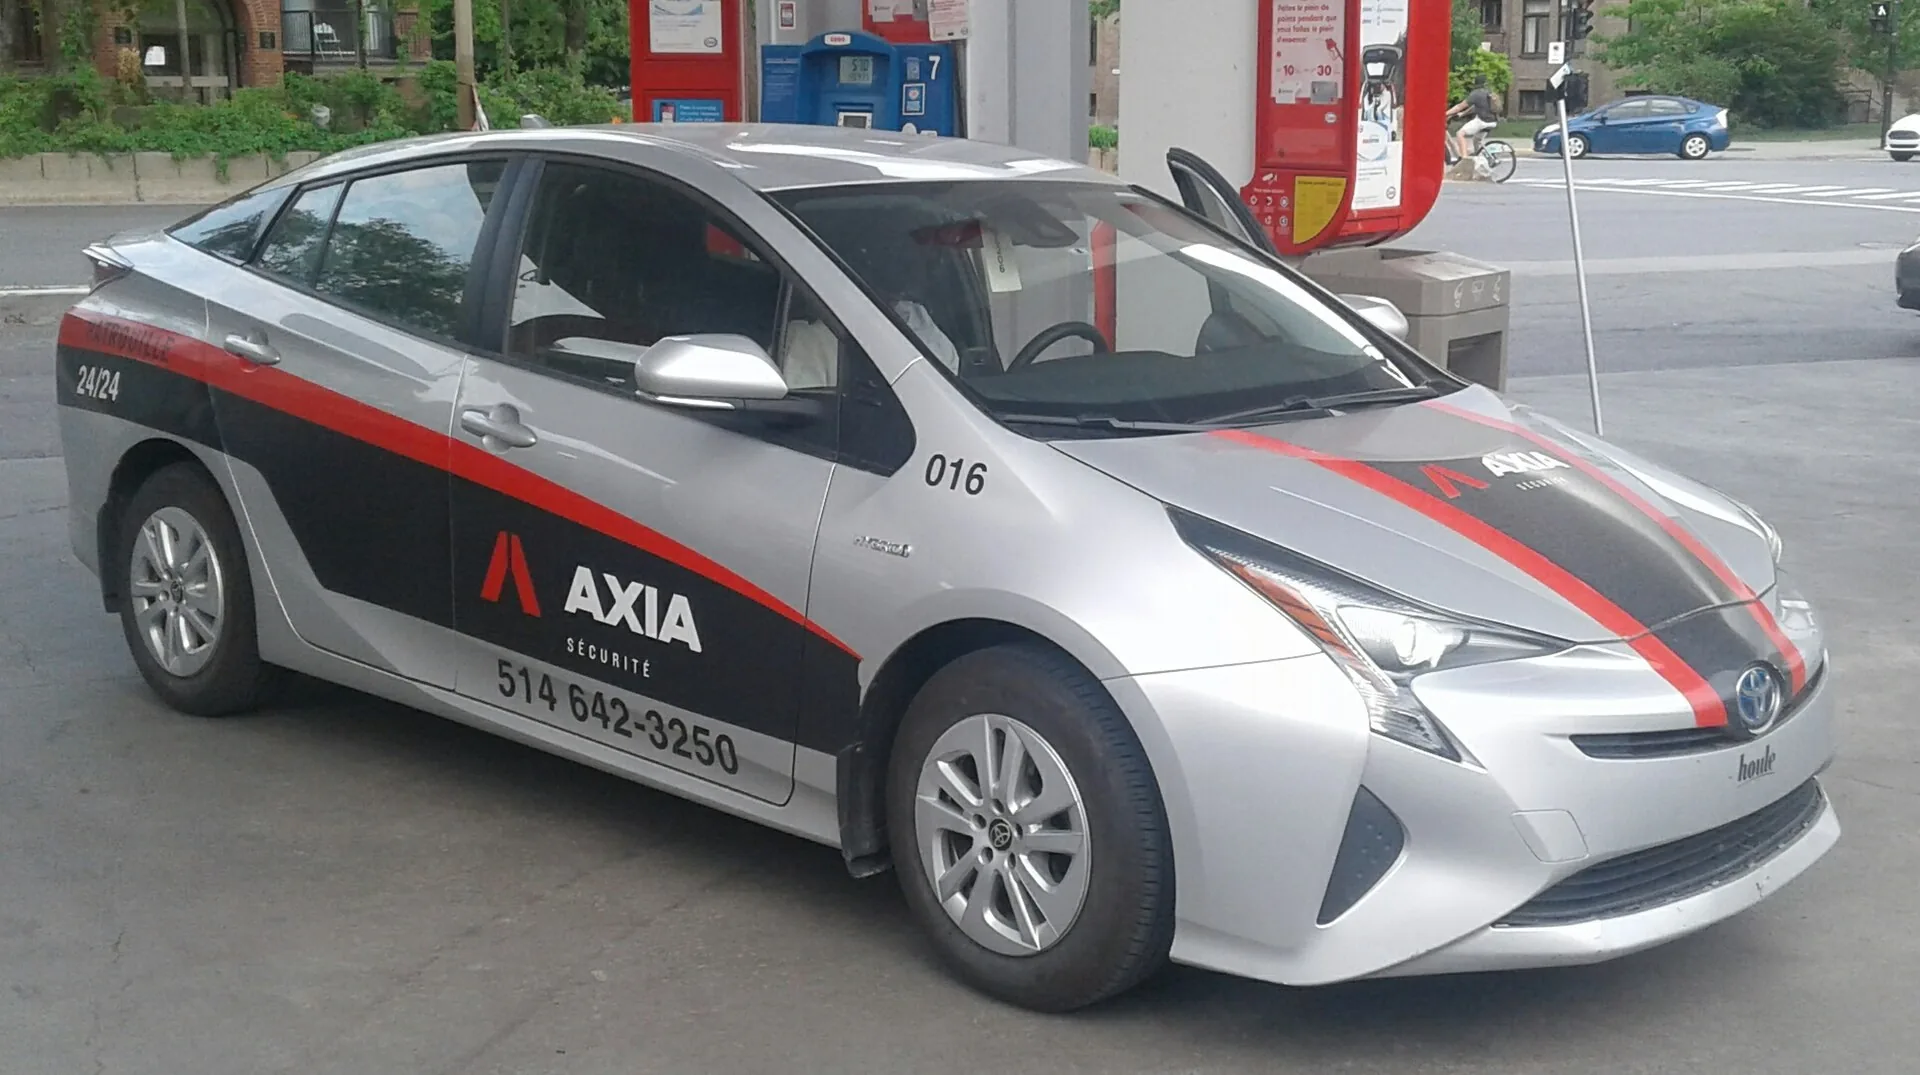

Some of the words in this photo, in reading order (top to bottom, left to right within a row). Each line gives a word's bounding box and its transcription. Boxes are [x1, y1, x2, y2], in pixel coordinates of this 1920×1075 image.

[928, 55, 941, 80] 7
[1283, 64, 1295, 76] 10
[1316, 64, 1332, 76] 30
[76, 365, 121, 402] 24/24
[925, 453, 988, 496] 016
[1481, 451, 1572, 477] AXIA
[563, 565, 702, 653] AXIA
[566, 637, 650, 678] SÉCURITÉ
[498, 659, 557, 712] 514
[568, 683, 739, 775] 642-3250
[1737, 744, 1776, 783] houle
